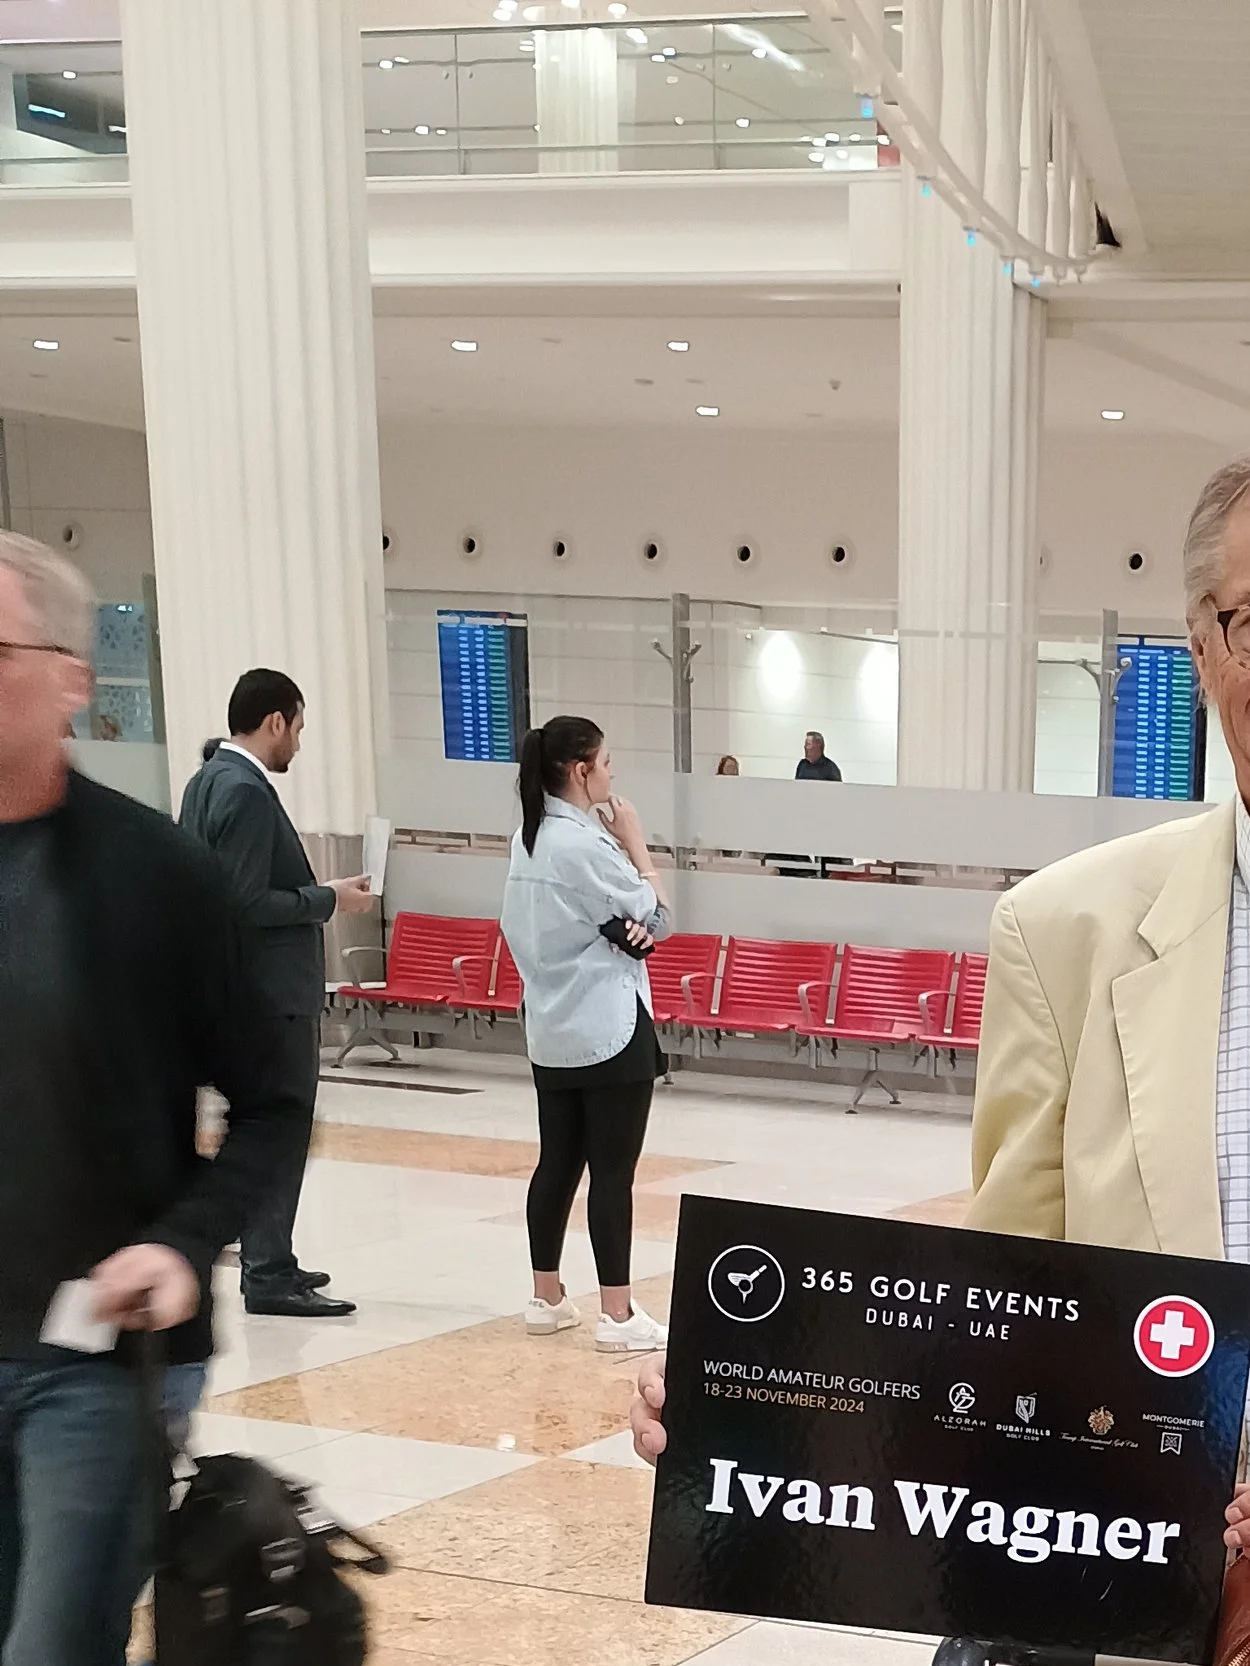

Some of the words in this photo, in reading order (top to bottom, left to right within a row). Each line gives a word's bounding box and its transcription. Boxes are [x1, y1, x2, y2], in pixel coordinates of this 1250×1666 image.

[801, 1267, 853, 1293] 365
[870, 1276, 951, 1304] GOLF
[966, 1287, 1079, 1321] EVENTS
[865, 1308, 933, 1330] DUBAI
[970, 1321, 1010, 1340] UAE
[703, 1360, 764, 1380] WORLD
[767, 1368, 845, 1391] AMATEUR
[849, 1378, 921, 1400] GOLFERS
[703, 1382, 742, 1399] 18-23
[746, 1387, 826, 1409] NOVEMBER
[829, 1397, 865, 1413] 2024
[996, 1423, 1023, 1433] DUBAI
[1025, 1427, 1051, 1436] HILLS
[1142, 1413, 1205, 1428] MONTGOMERIE
[705, 1458, 875, 1531] Ivan
[894, 1479, 1181, 1565] Wagner
